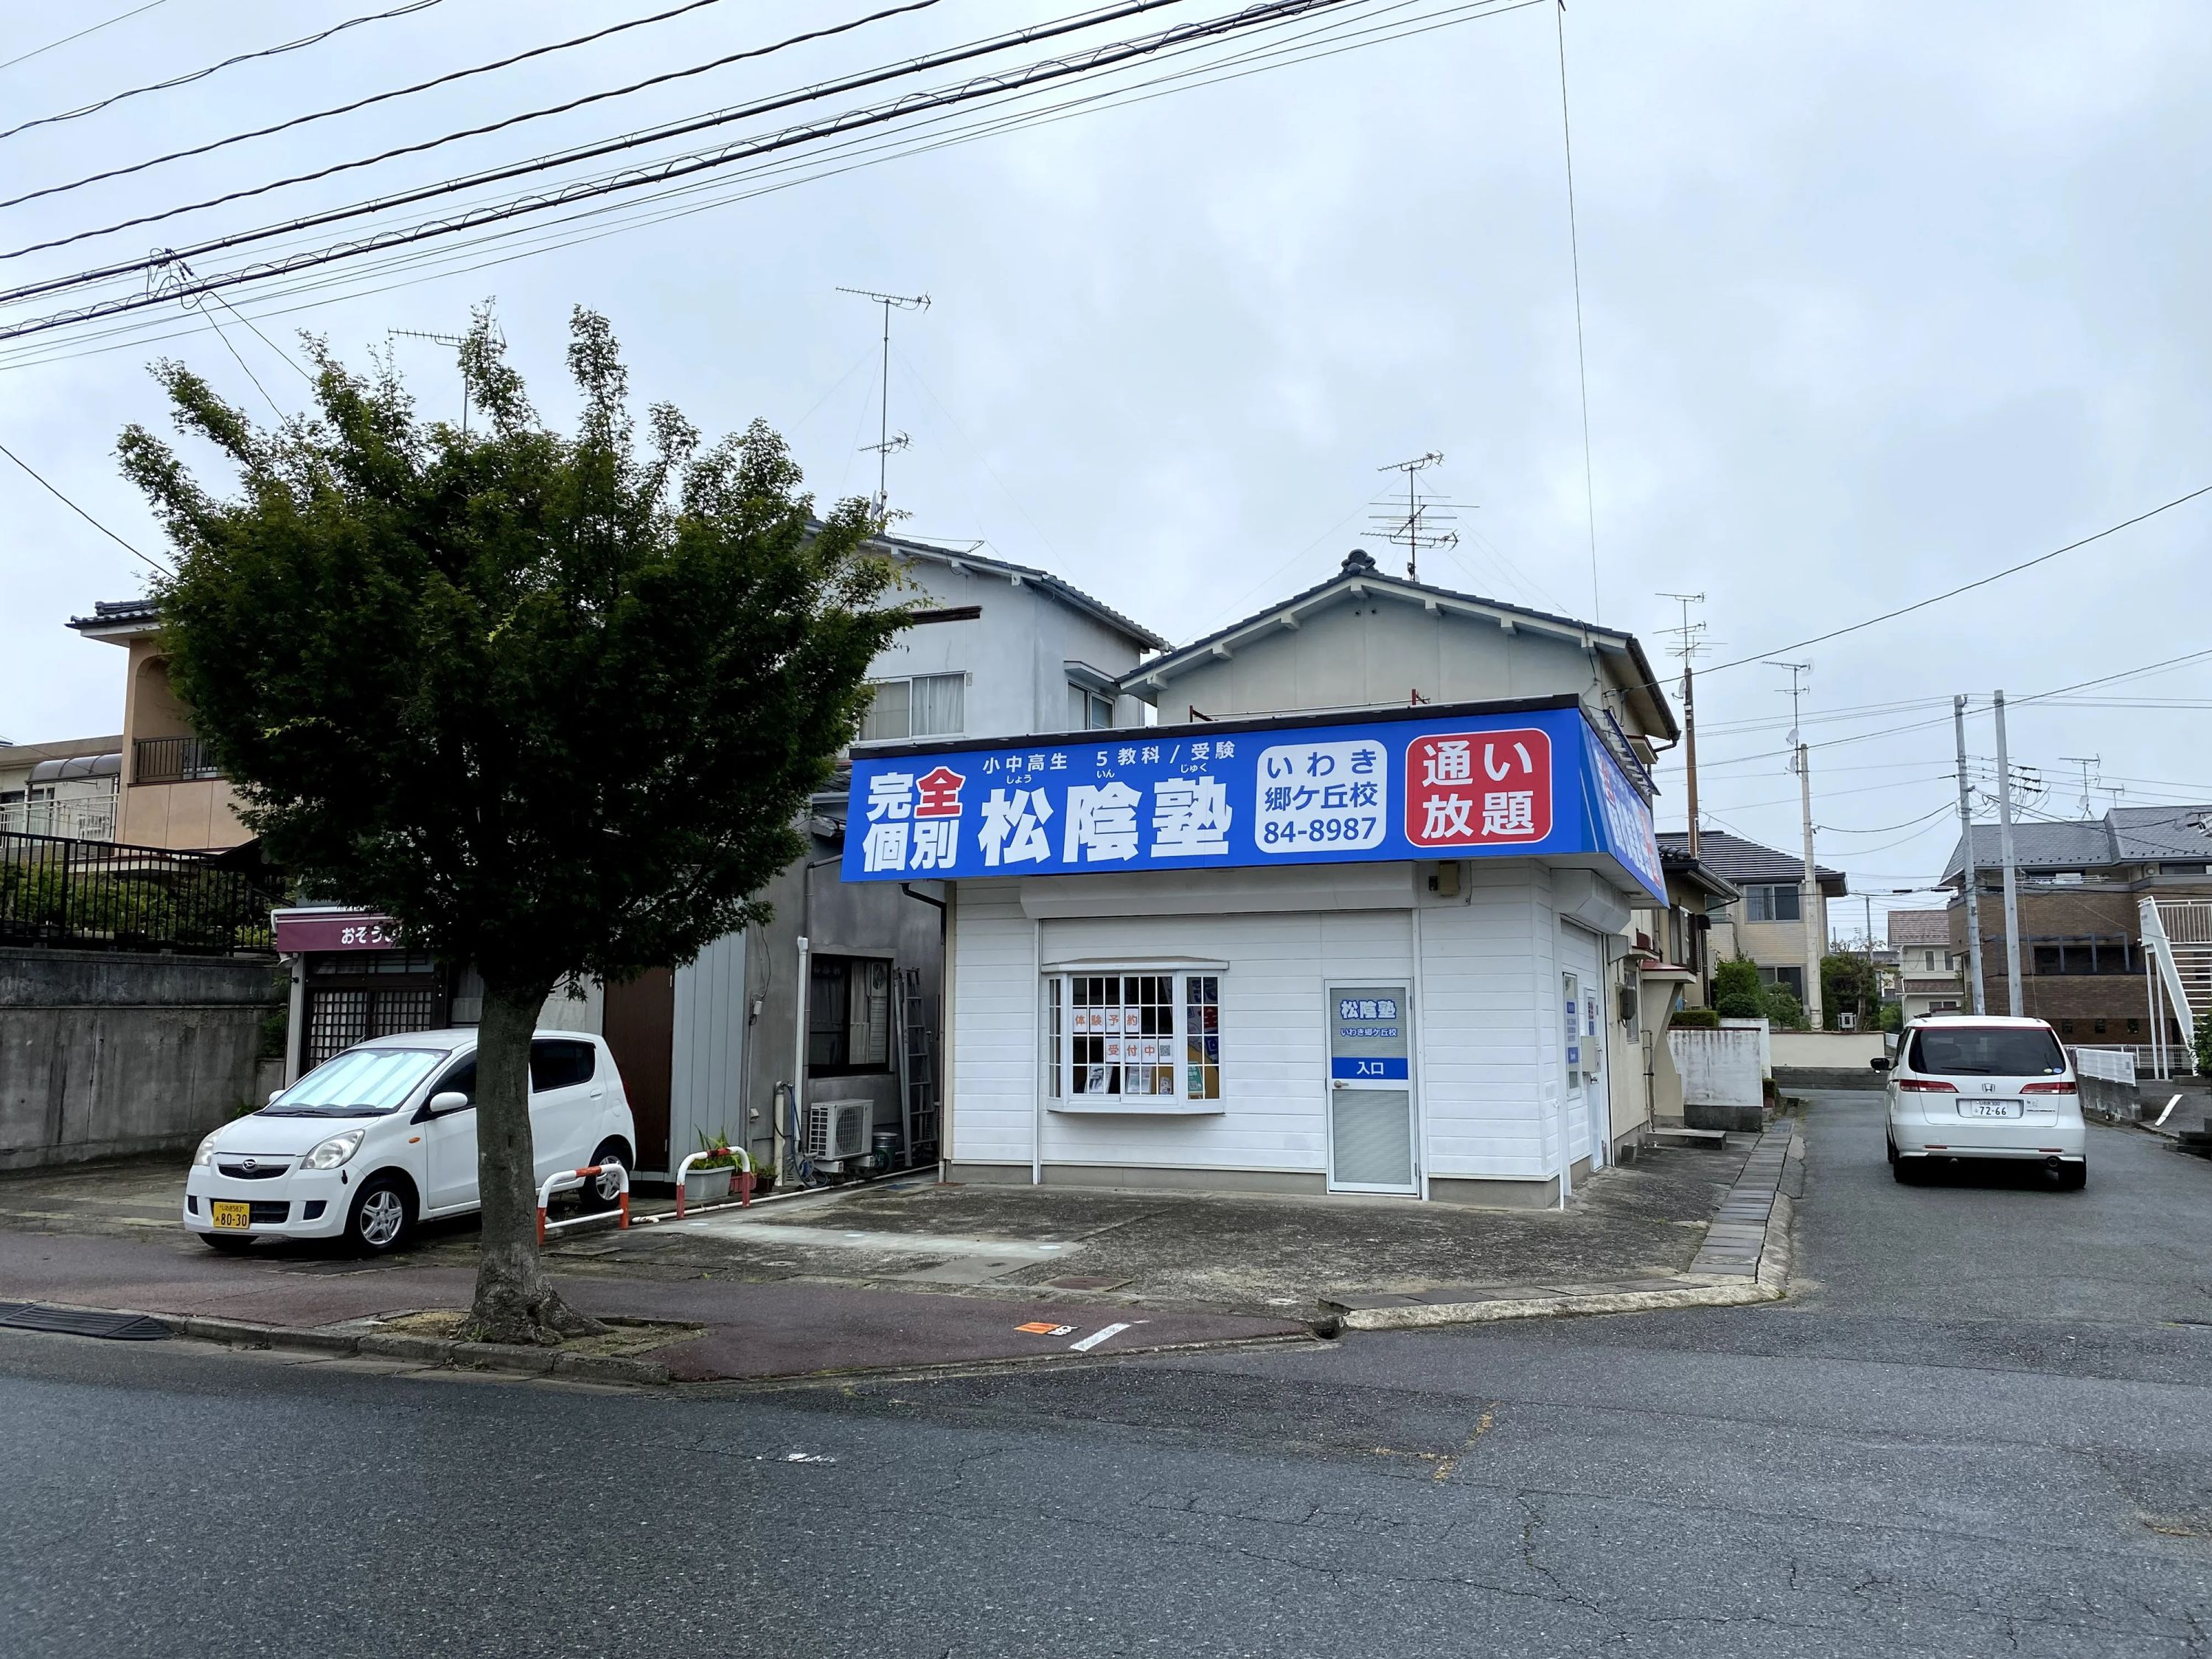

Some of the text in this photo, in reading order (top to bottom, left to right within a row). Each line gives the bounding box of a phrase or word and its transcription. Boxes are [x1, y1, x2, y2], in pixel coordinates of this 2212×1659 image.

[983, 752, 1067, 775] 小中高生
[1096, 769, 1116, 779] いん
[1180, 763, 1208, 773] じゅく
[1267, 748, 1377, 779] いわき
[1422, 740, 1532, 788] 通い
[1006, 774, 1032, 785] しょう
[866, 766, 967, 822] 完全
[978, 776, 1233, 867] 松陰塾
[1420, 790, 1534, 840] 放題
[1263, 817, 1377, 844] 84-8987
[862, 819, 959, 872] 個別
[1340, 999, 1397, 1020] 松陰塾
[1074, 1014, 1138, 1027] 体験予約
[1107, 1043, 1155, 1057] 受付中
[1356, 1061, 1385, 1076] 入口
[1980, 1106, 2006, 1115] 72-66
[221, 1213, 247, 1227] 80-30
